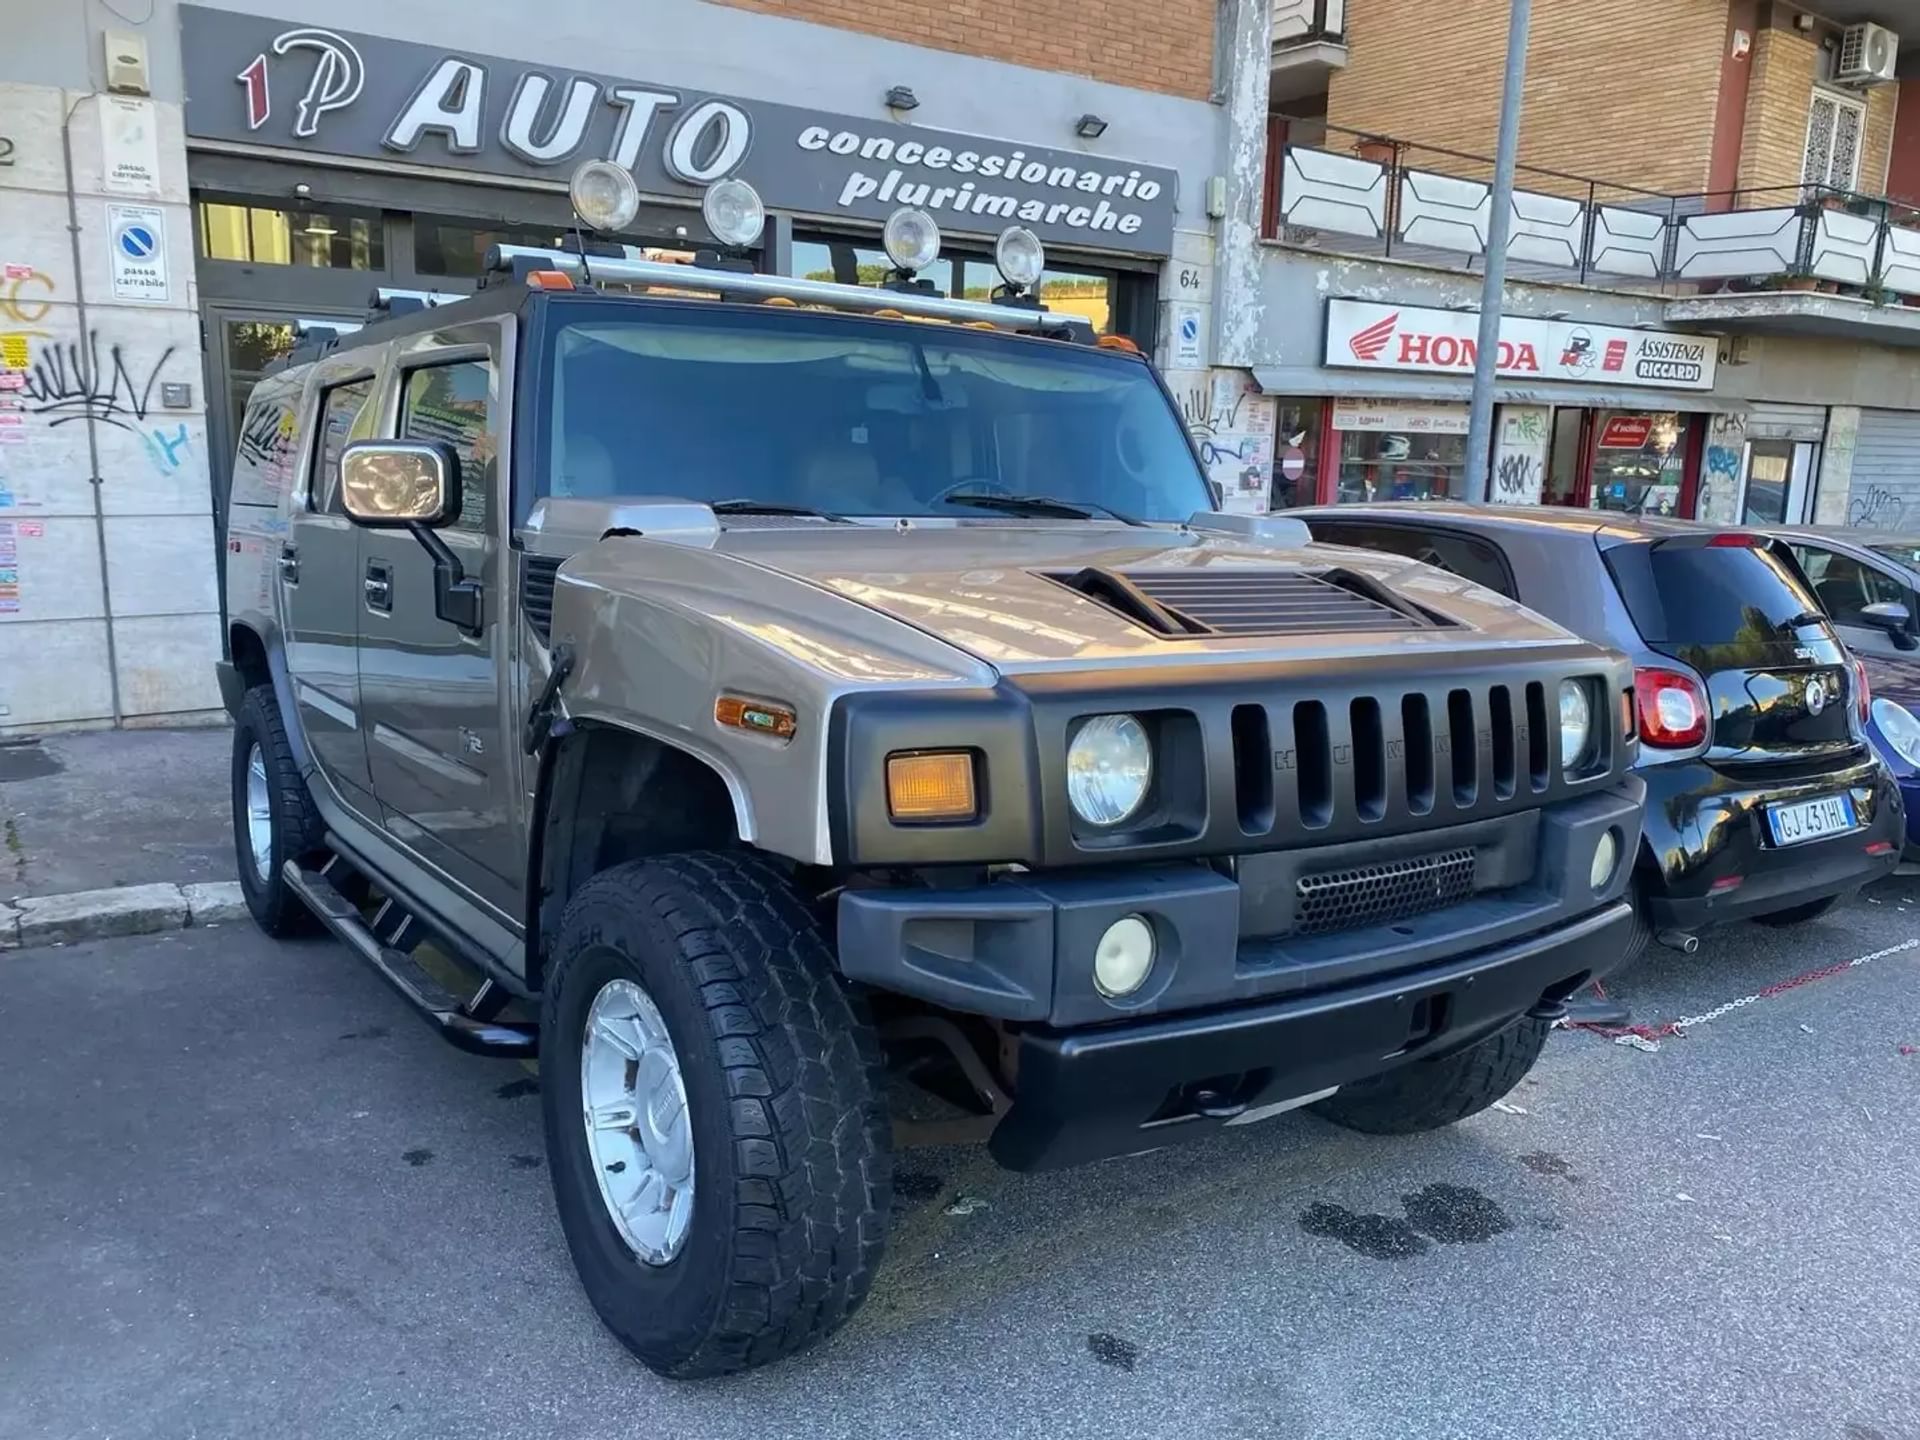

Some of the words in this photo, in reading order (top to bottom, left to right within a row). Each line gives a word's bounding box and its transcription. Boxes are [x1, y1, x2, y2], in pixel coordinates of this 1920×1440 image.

[382, 55, 754, 186] AUTO
[117, 163, 146, 173] passo
[798, 125, 1161, 202] concessionario
[837, 168, 1144, 234] plurimarche
[116, 277, 165, 288] carrabile
[123, 267, 156, 277] passo
[1179, 269, 1200, 289] 64
[1397, 333, 1540, 372] HONDA
[1636, 337, 1706, 362] ASSISTENZA
[1638, 361, 1700, 381] RICCARDI
[1780, 808, 1801, 838] GJ
[1805, 799, 1847, 833] 431HL
